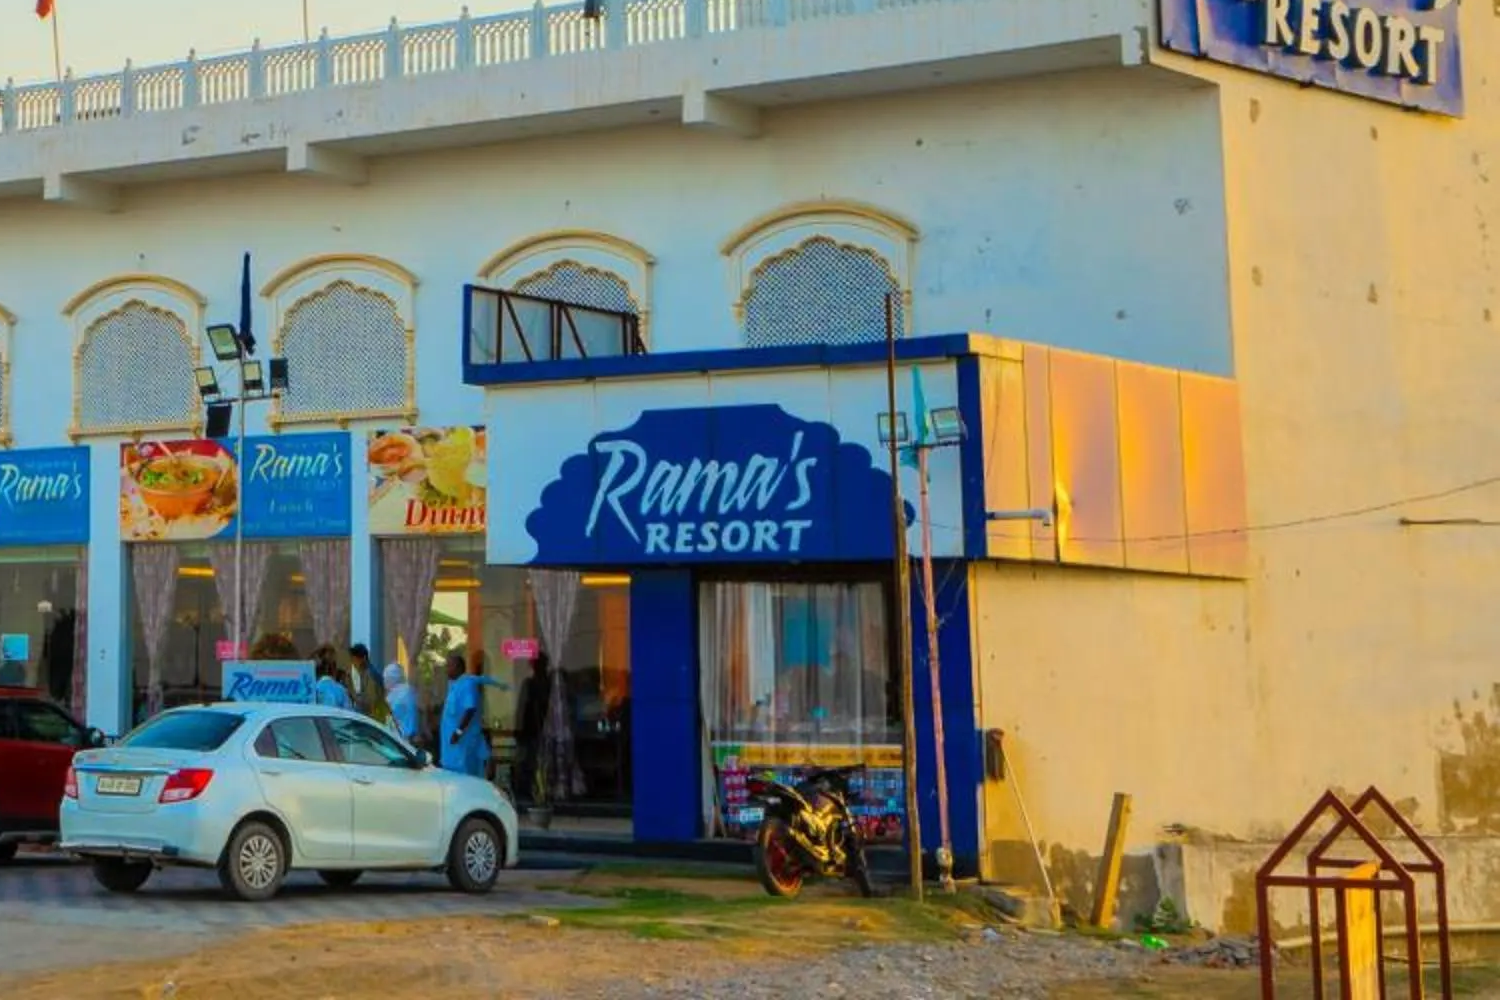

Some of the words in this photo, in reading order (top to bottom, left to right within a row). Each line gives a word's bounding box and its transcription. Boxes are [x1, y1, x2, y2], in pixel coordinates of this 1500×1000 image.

[249, 443, 343, 484] Rama's
[585, 431, 819, 544] Rama's
[645, 519, 813, 555] RESORT
[227, 671, 313, 701] Rama's
